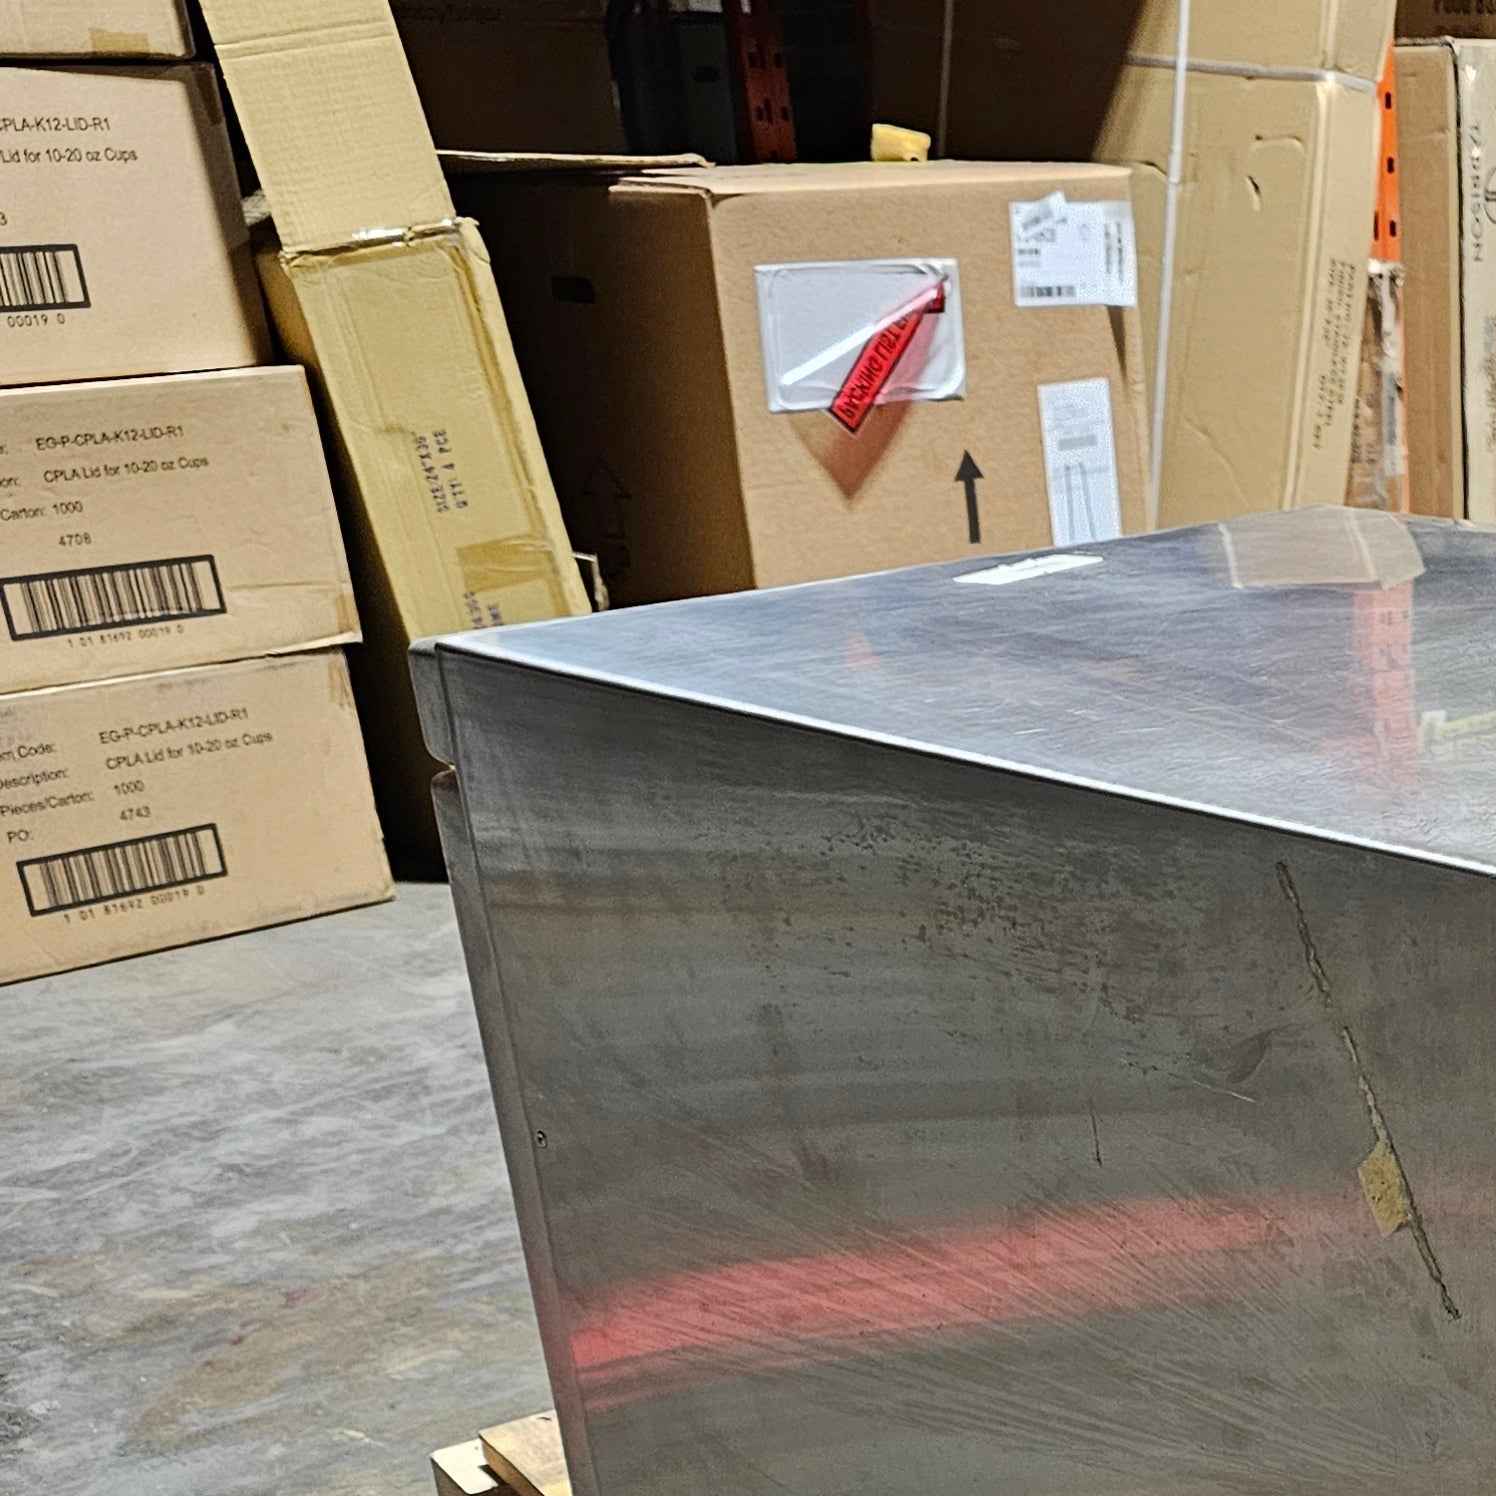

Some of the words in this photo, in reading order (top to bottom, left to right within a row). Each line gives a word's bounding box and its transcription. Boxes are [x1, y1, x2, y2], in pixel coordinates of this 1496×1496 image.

[0, 117, 110, 132] PLA-K12-LID-R1
[24, 148, 41, 163] for
[46, 148, 82, 162] 10-20
[86, 150, 101, 162] oz
[104, 147, 138, 164] Cups
[44, 468, 81, 483] CPLA
[124, 460, 158, 474] 10-20
[179, 456, 209, 470] Cups
[52, 500, 84, 516] 1000
[106, 753, 145, 770] CPLA
[146, 748, 165, 764] Lid
[113, 780, 145, 796] 1000
